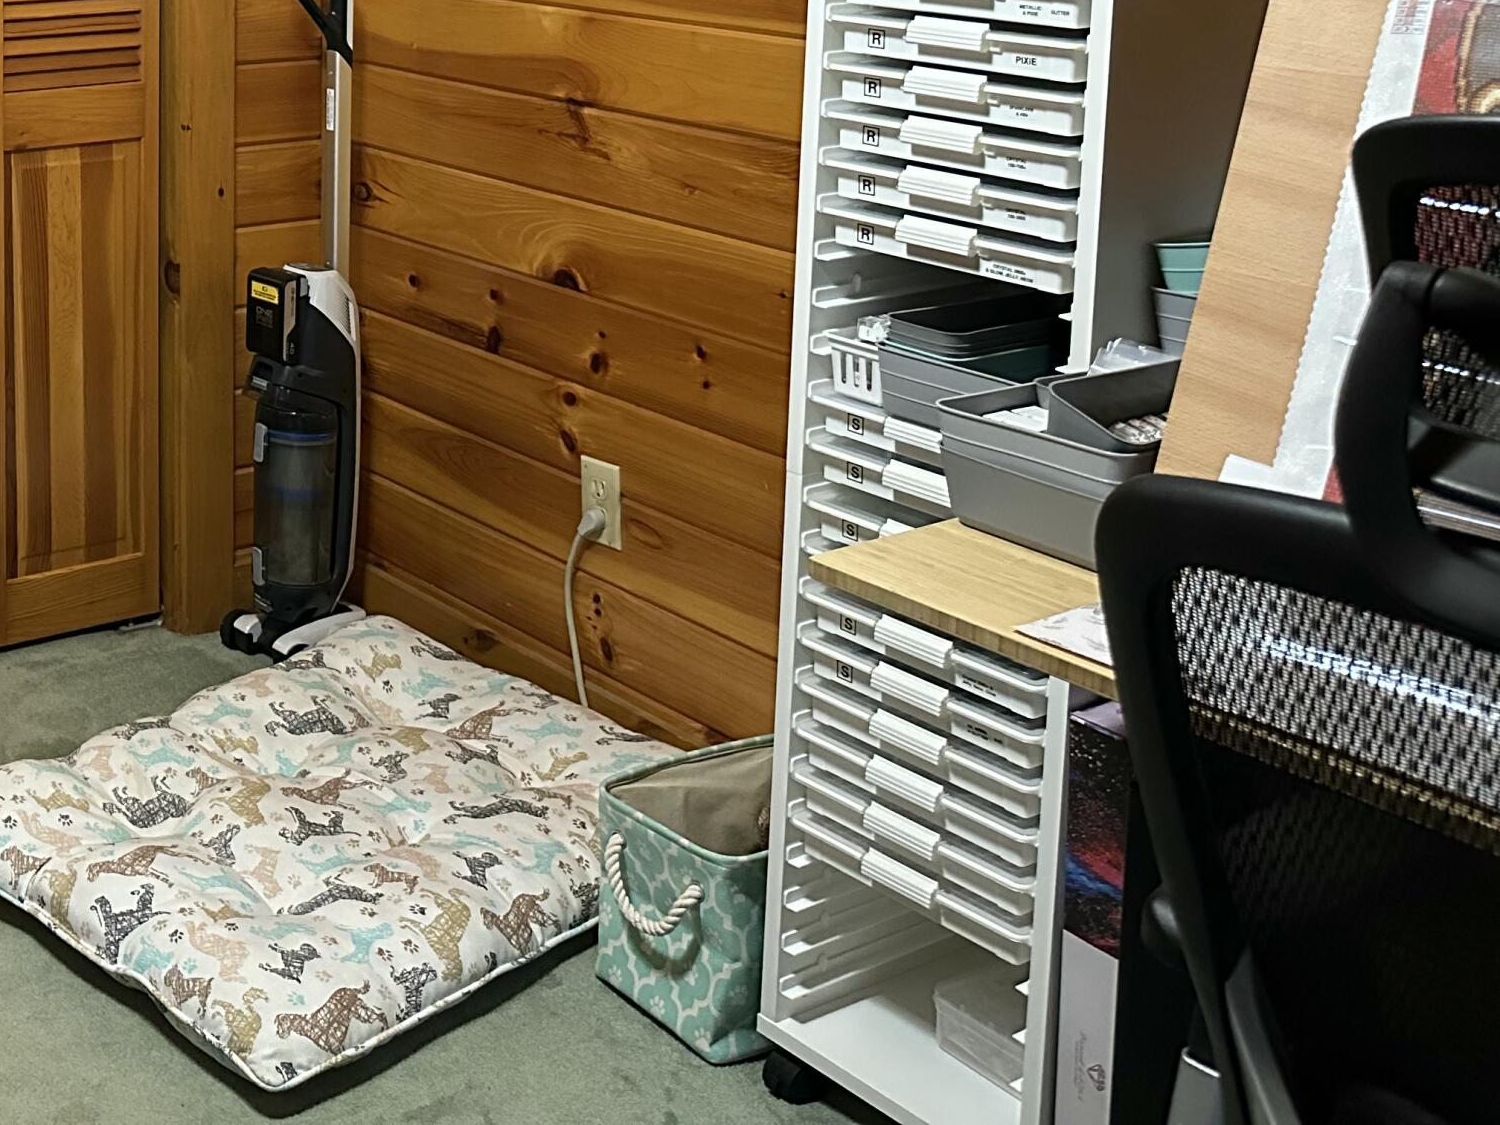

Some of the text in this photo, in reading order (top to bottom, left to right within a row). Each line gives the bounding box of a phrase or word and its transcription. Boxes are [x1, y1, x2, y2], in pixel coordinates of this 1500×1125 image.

[871, 32, 881, 45] R
[1015, 56, 1037, 66] PIXIE
[868, 81, 877, 94] R
[867, 129, 875, 143] R
[862, 179, 871, 192] R
[861, 227, 870, 241] R
[851, 418, 860, 430] S
[851, 466, 859, 479] S
[846, 524, 855, 536] S
[844, 617, 853, 631] S
[841, 665, 849, 678] S
